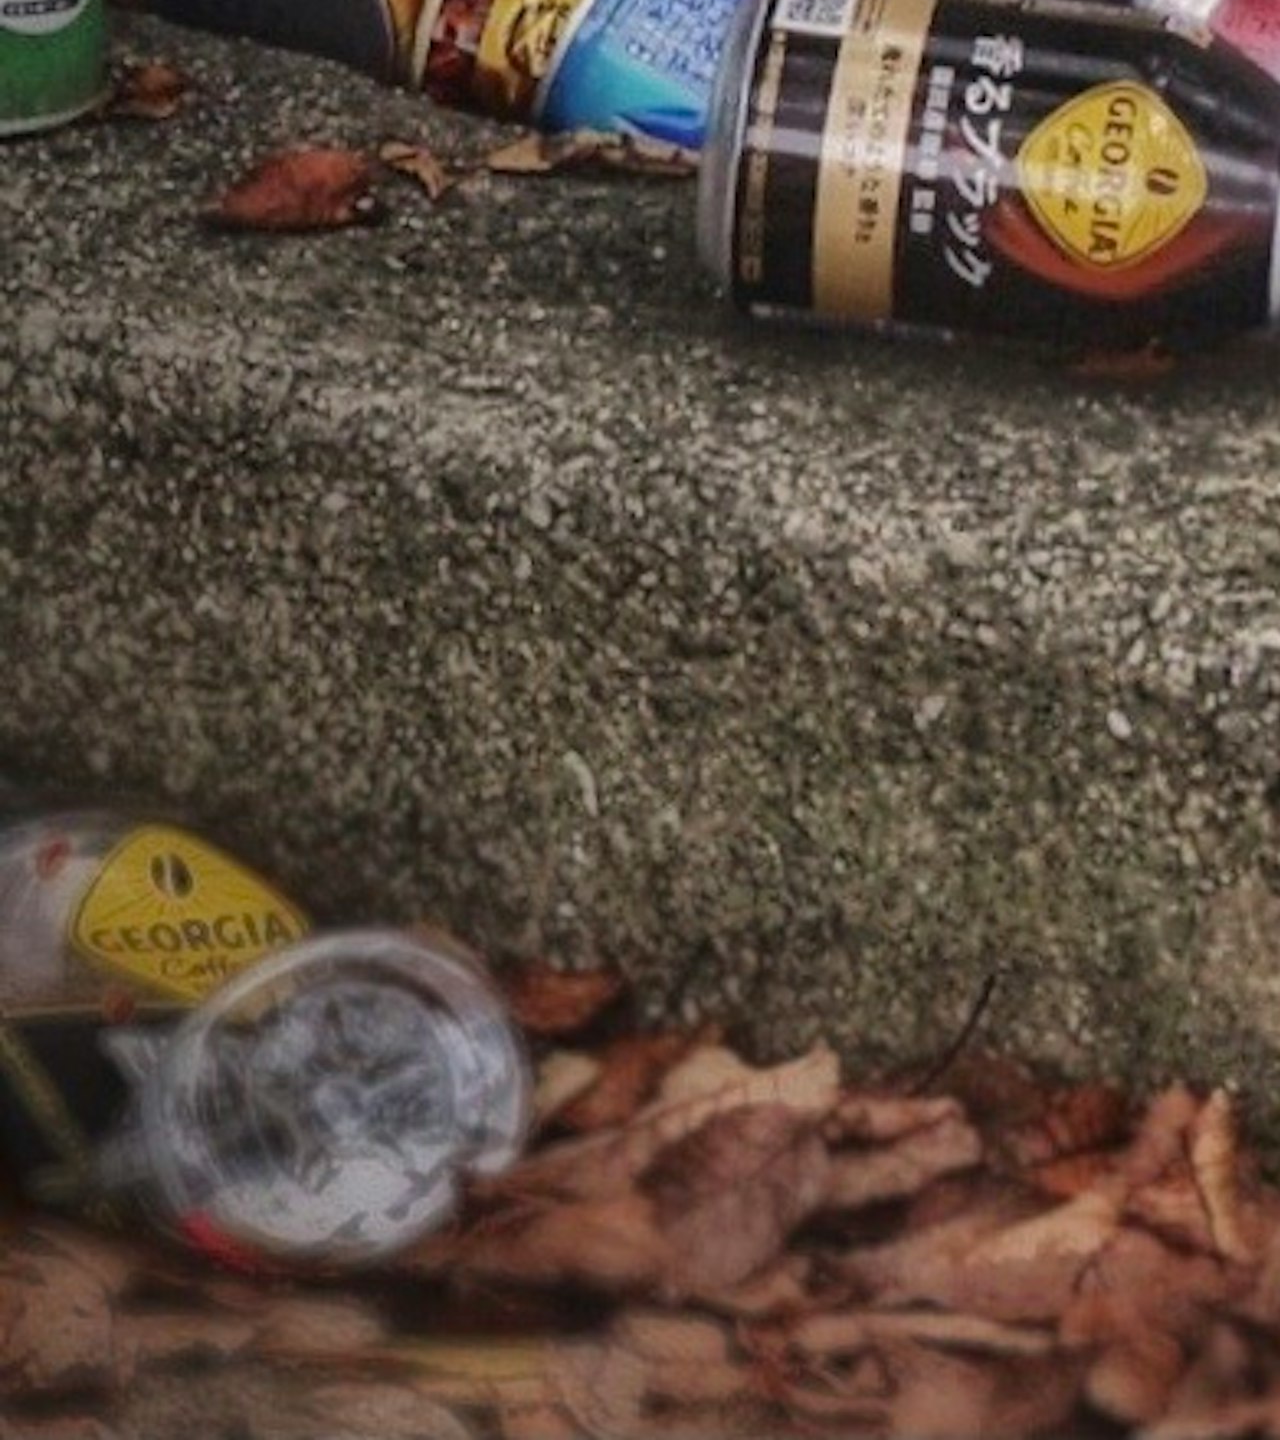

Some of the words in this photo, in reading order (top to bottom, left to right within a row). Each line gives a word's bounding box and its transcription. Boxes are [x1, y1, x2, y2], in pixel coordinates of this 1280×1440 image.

[944, 34, 1023, 288] 香るブラック
[1088, 94, 1138, 262] GEORGIA
[90, 912, 295, 954] GEORGIA
